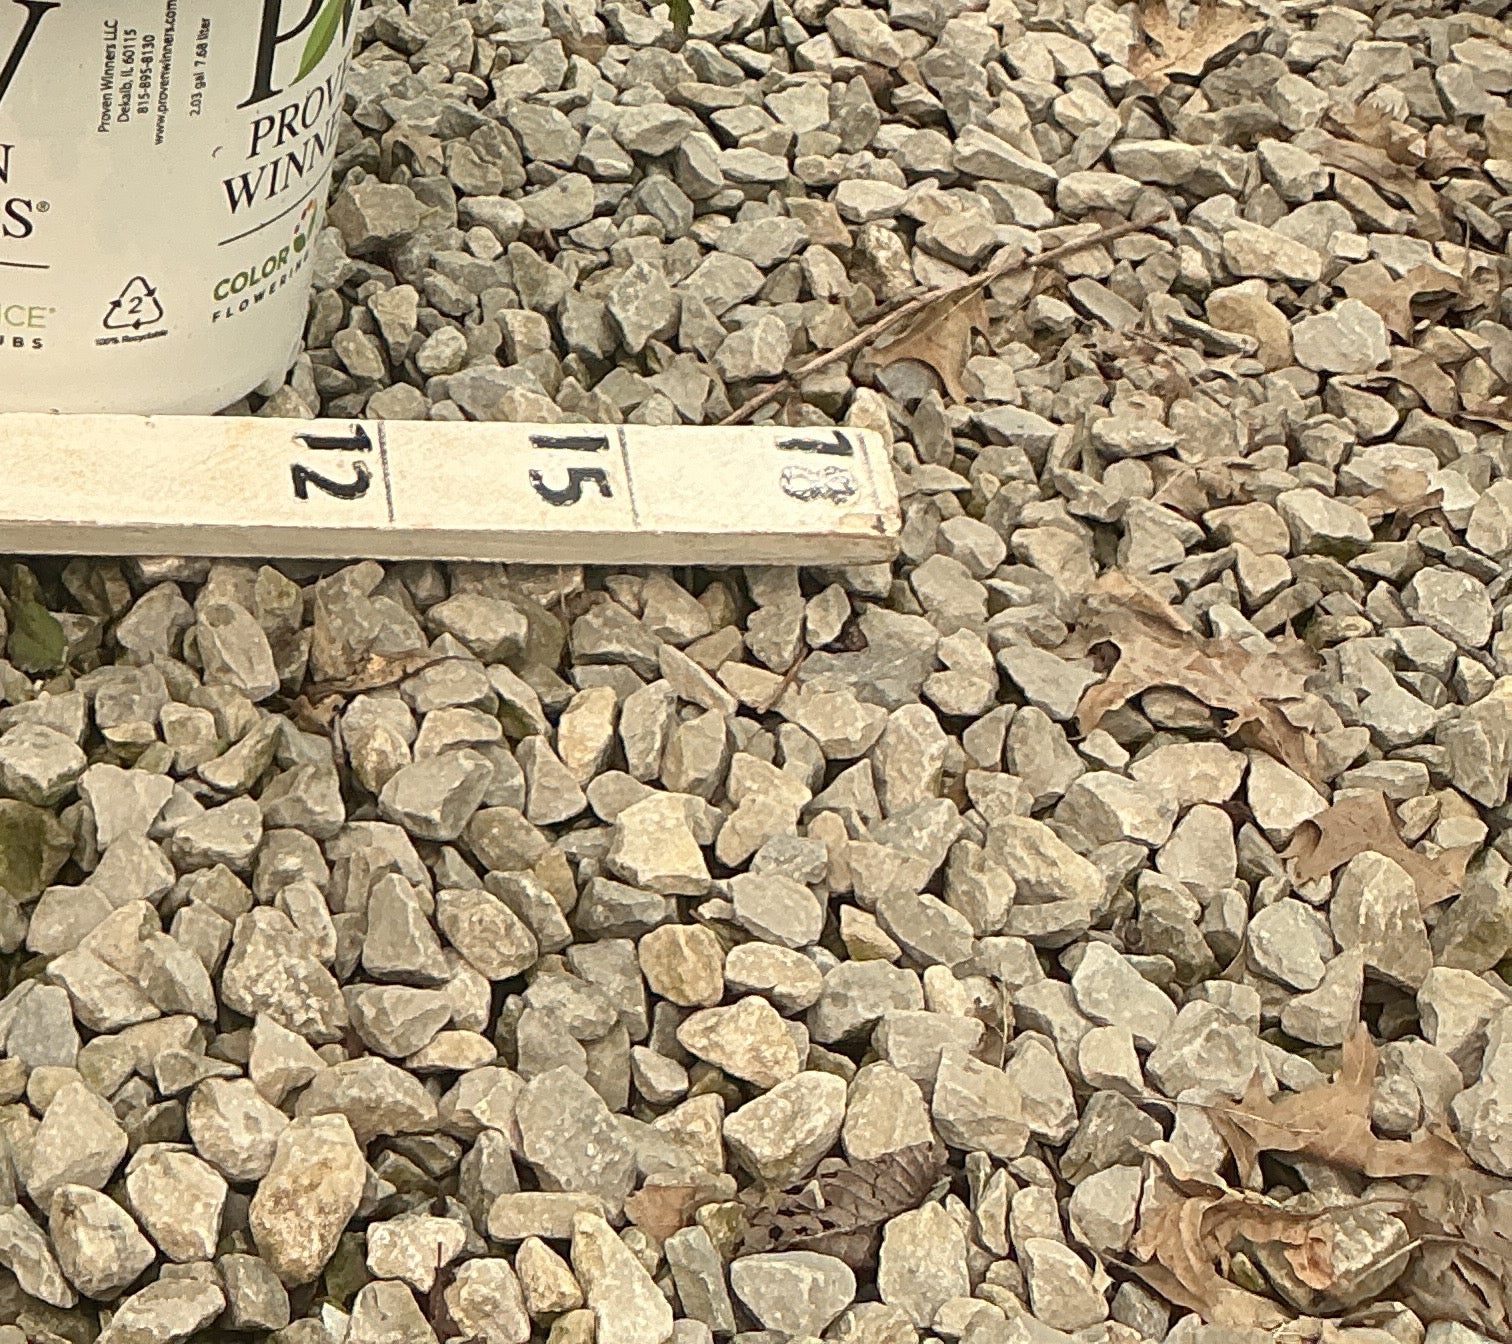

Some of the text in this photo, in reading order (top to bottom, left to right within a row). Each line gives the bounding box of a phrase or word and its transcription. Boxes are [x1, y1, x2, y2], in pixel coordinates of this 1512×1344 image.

[97, 19, 119, 133] Proven Winners LLC
[121, 28, 137, 65] 60115
[136, 34, 156, 115] 815-895-8130
[192, 71, 207, 90] gal
[245, 57, 346, 161] PROV
[223, 110, 338, 215] WINN
[127, 296, 144, 315] 2
[213, 245, 291, 302] COLOR
[290, 423, 373, 501] 12
[528, 433, 614, 507] 15
